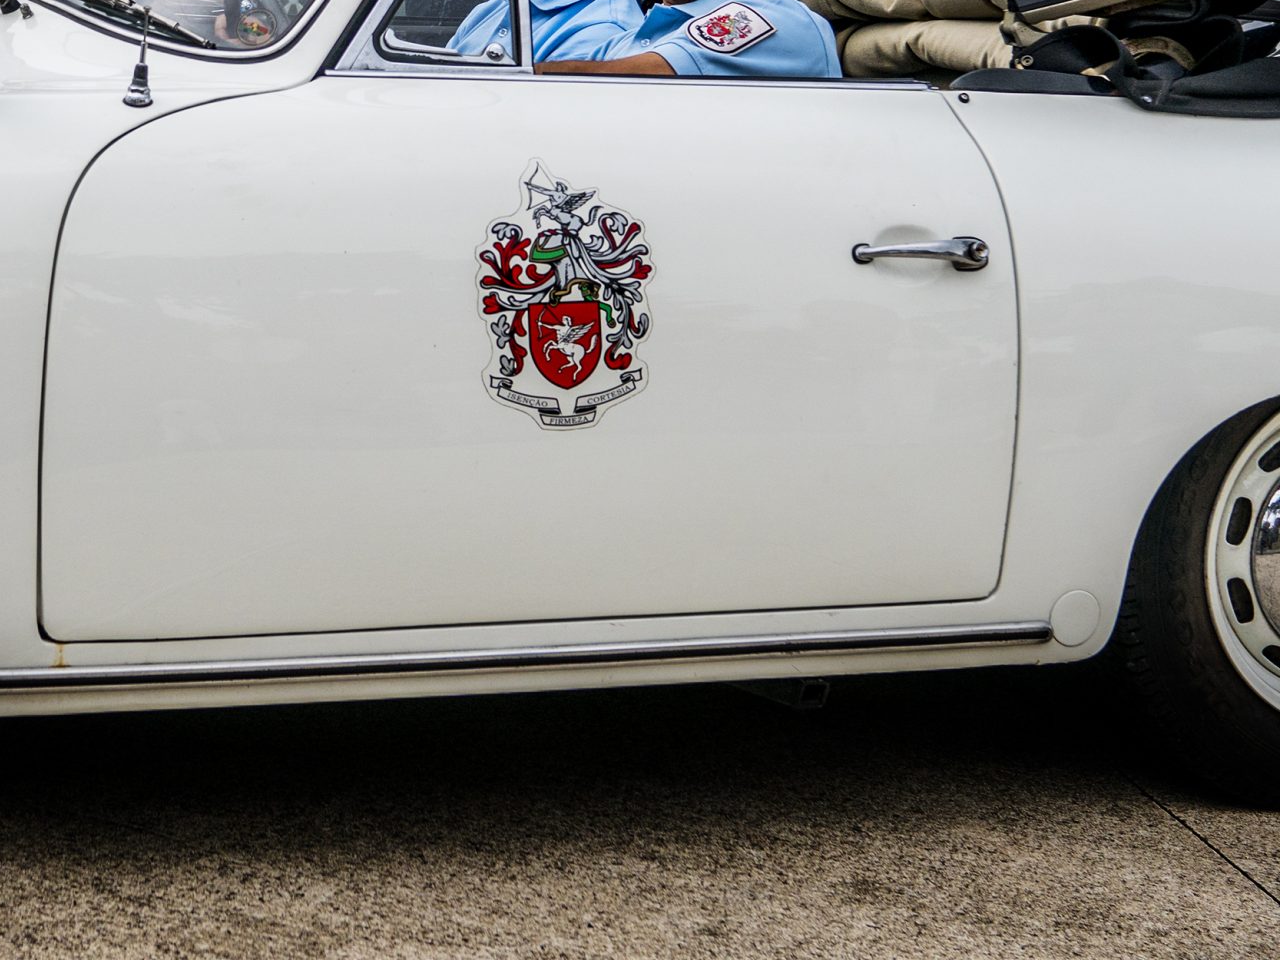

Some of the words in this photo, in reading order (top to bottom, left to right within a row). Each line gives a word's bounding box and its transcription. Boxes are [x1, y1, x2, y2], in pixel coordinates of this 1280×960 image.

[506, 392, 549, 408] ISENÇÃO
[586, 384, 632, 405] CORTESIA
[549, 415, 589, 425] FIRMEZA
